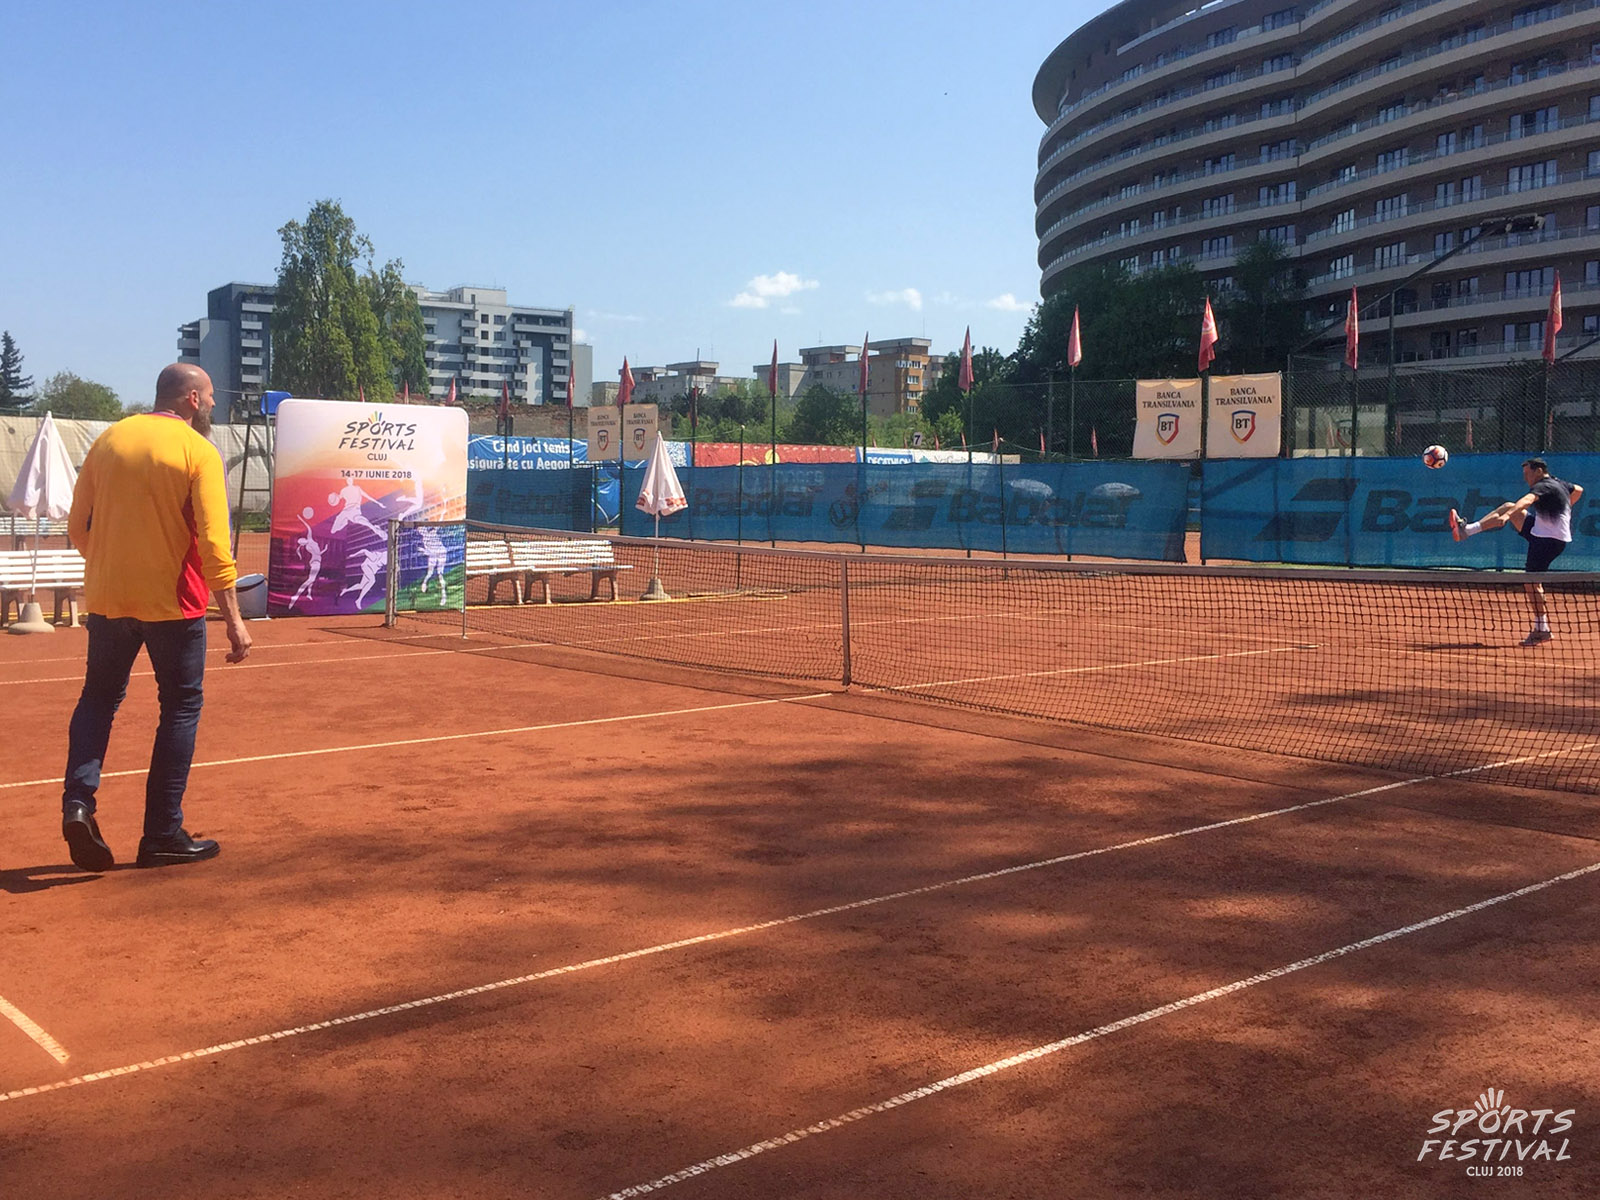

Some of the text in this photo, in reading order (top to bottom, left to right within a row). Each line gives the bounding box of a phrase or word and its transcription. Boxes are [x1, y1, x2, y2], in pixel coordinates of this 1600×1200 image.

[1156, 391, 1181, 399] BANCA
[1229, 387, 1257, 396] BANCA
[1142, 400, 1195, 408] TRANSILVANIA
[1215, 395, 1273, 406] TRANSILVANIA
[344, 420, 417, 437] SPORTS
[1160, 421, 1174, 431] BT
[1235, 418, 1251, 429] BT
[338, 437, 415, 451] FESTIVAL
[914, 435, 921, 445] 7
[522, 440, 542, 456] joci
[367, 453, 387, 461] CLUJ
[521, 460, 534, 470] cu
[341, 470, 412, 479] 14-17 IUNIE 2018
